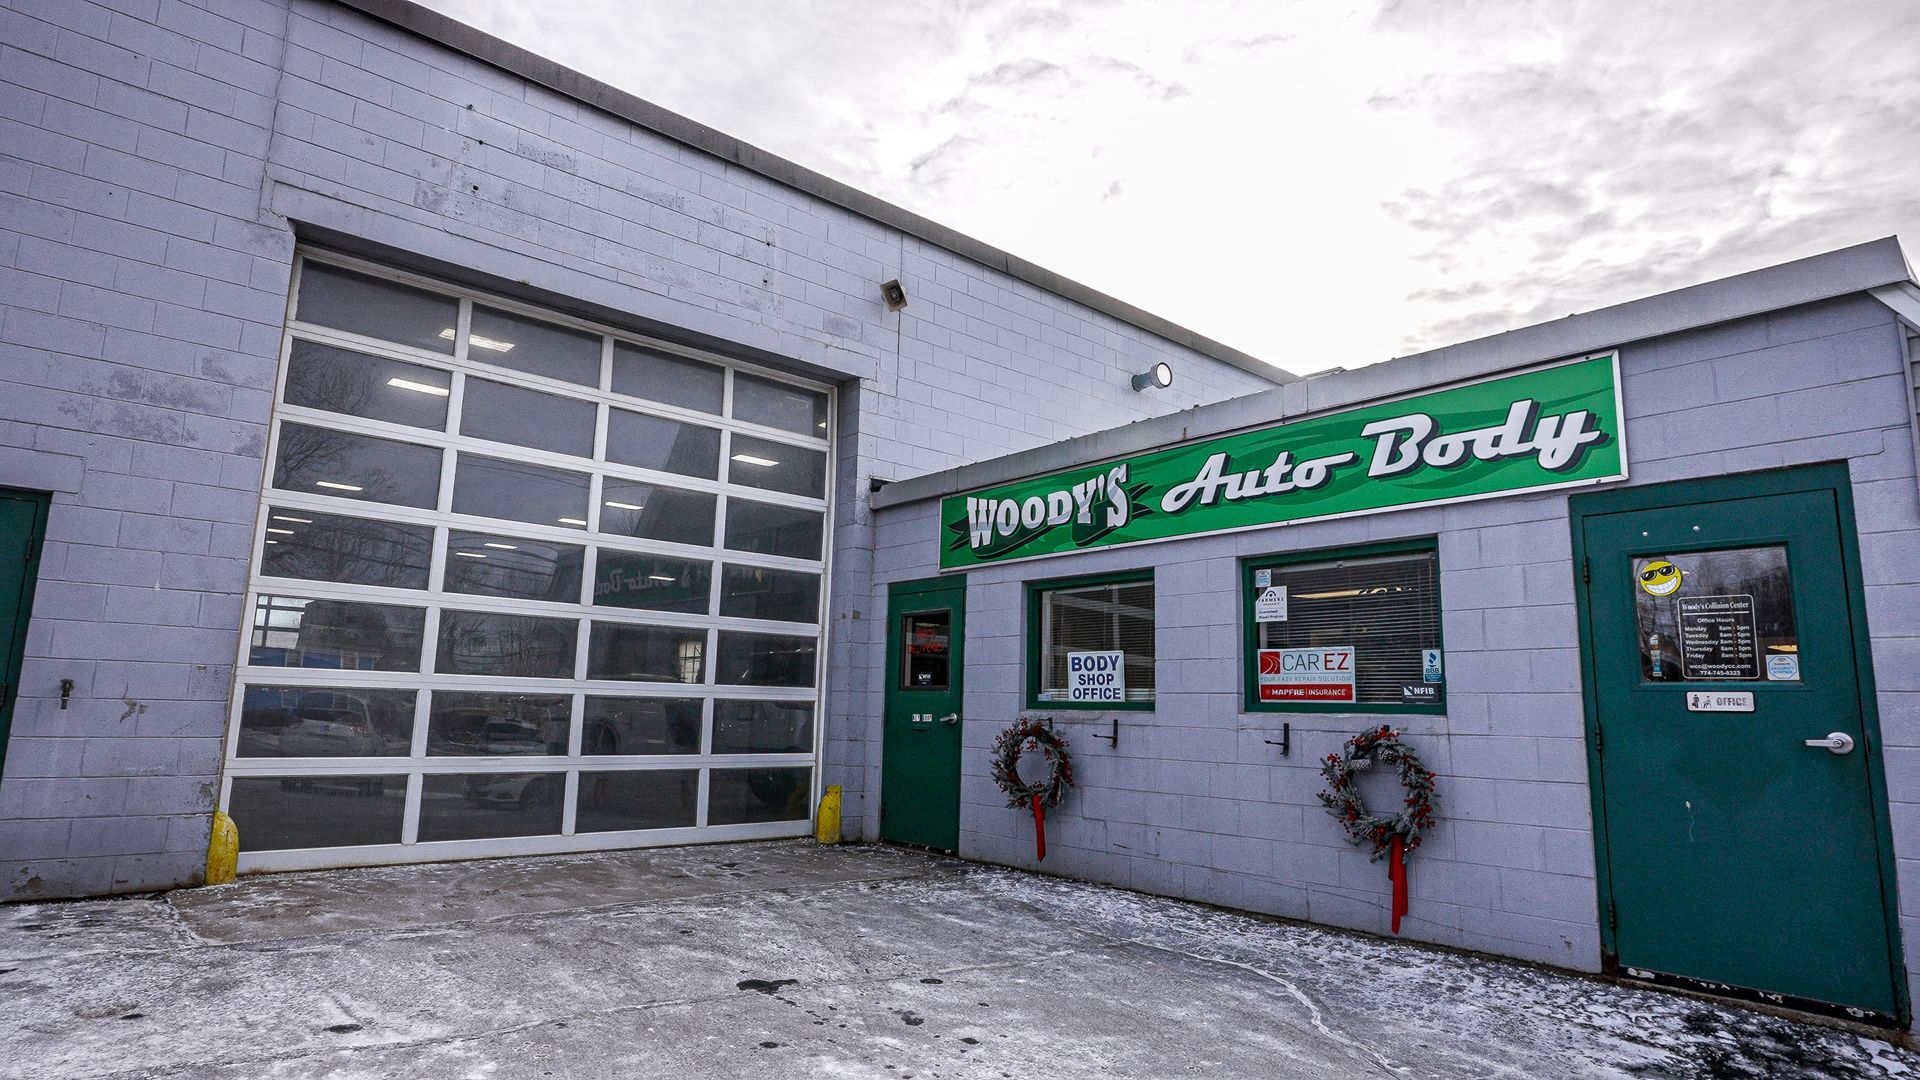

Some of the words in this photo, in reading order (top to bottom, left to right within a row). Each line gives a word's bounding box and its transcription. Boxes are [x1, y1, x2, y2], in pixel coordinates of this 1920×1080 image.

[966, 463, 1128, 549] WOODY'S
[1160, 449, 1356, 513] Auto
[1359, 399, 1601, 478] Body
[1705, 601, 1729, 609] Collision
[1071, 655, 1120, 672] BODY
[1282, 654, 1320, 671] CAR
[1324, 653, 1350, 670] EZ
[1078, 673, 1115, 686] SHOP
[1073, 688, 1121, 700] OFFICE
[1414, 687, 1434, 695] NFIB
[1716, 697, 1747, 706] OFFICE
